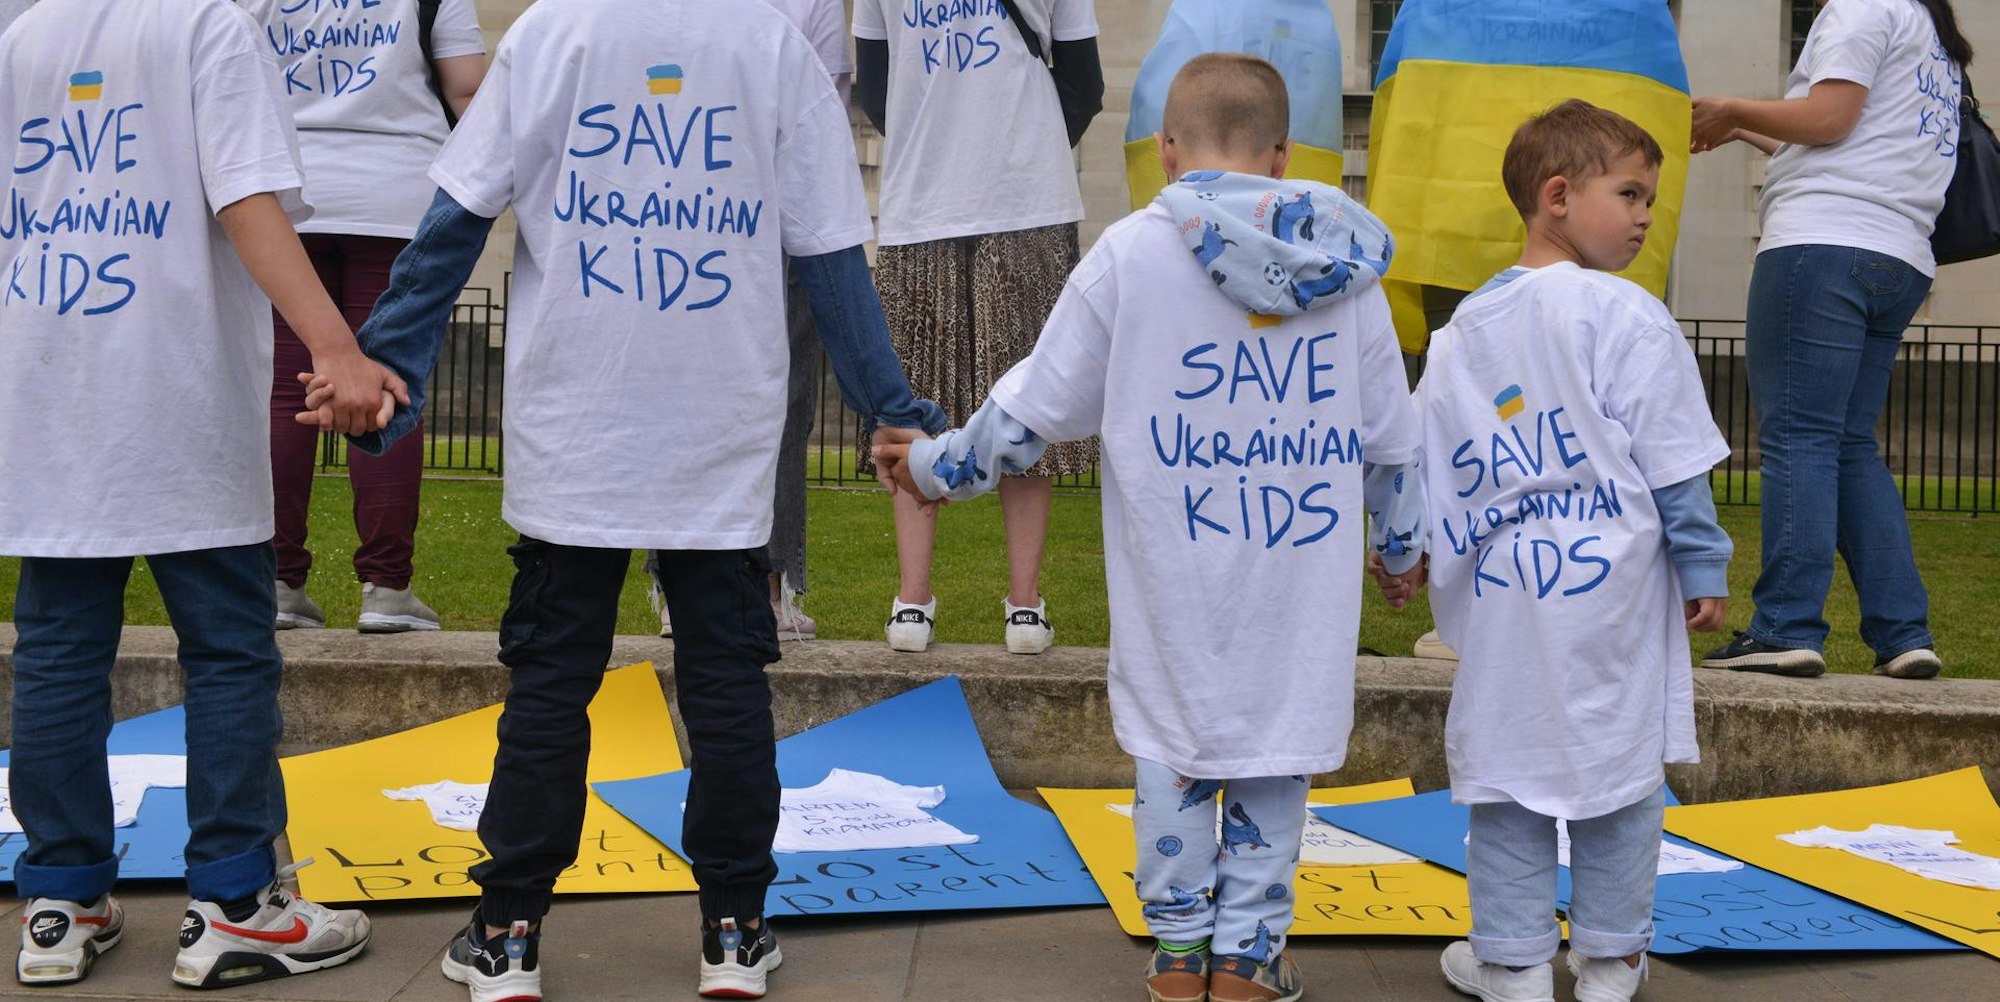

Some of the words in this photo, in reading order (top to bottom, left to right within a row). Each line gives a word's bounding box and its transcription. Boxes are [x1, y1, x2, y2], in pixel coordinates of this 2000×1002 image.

[14, 103, 143, 174] SAVE
[568, 103, 737, 171] SAVE
[1175, 332, 1337, 404] SAVE
[1452, 407, 1587, 498] SAVE
[901, 613, 919, 622] NIKE
[1016, 614, 1033, 623] NIKE
[802, 815, 826, 826] 5
